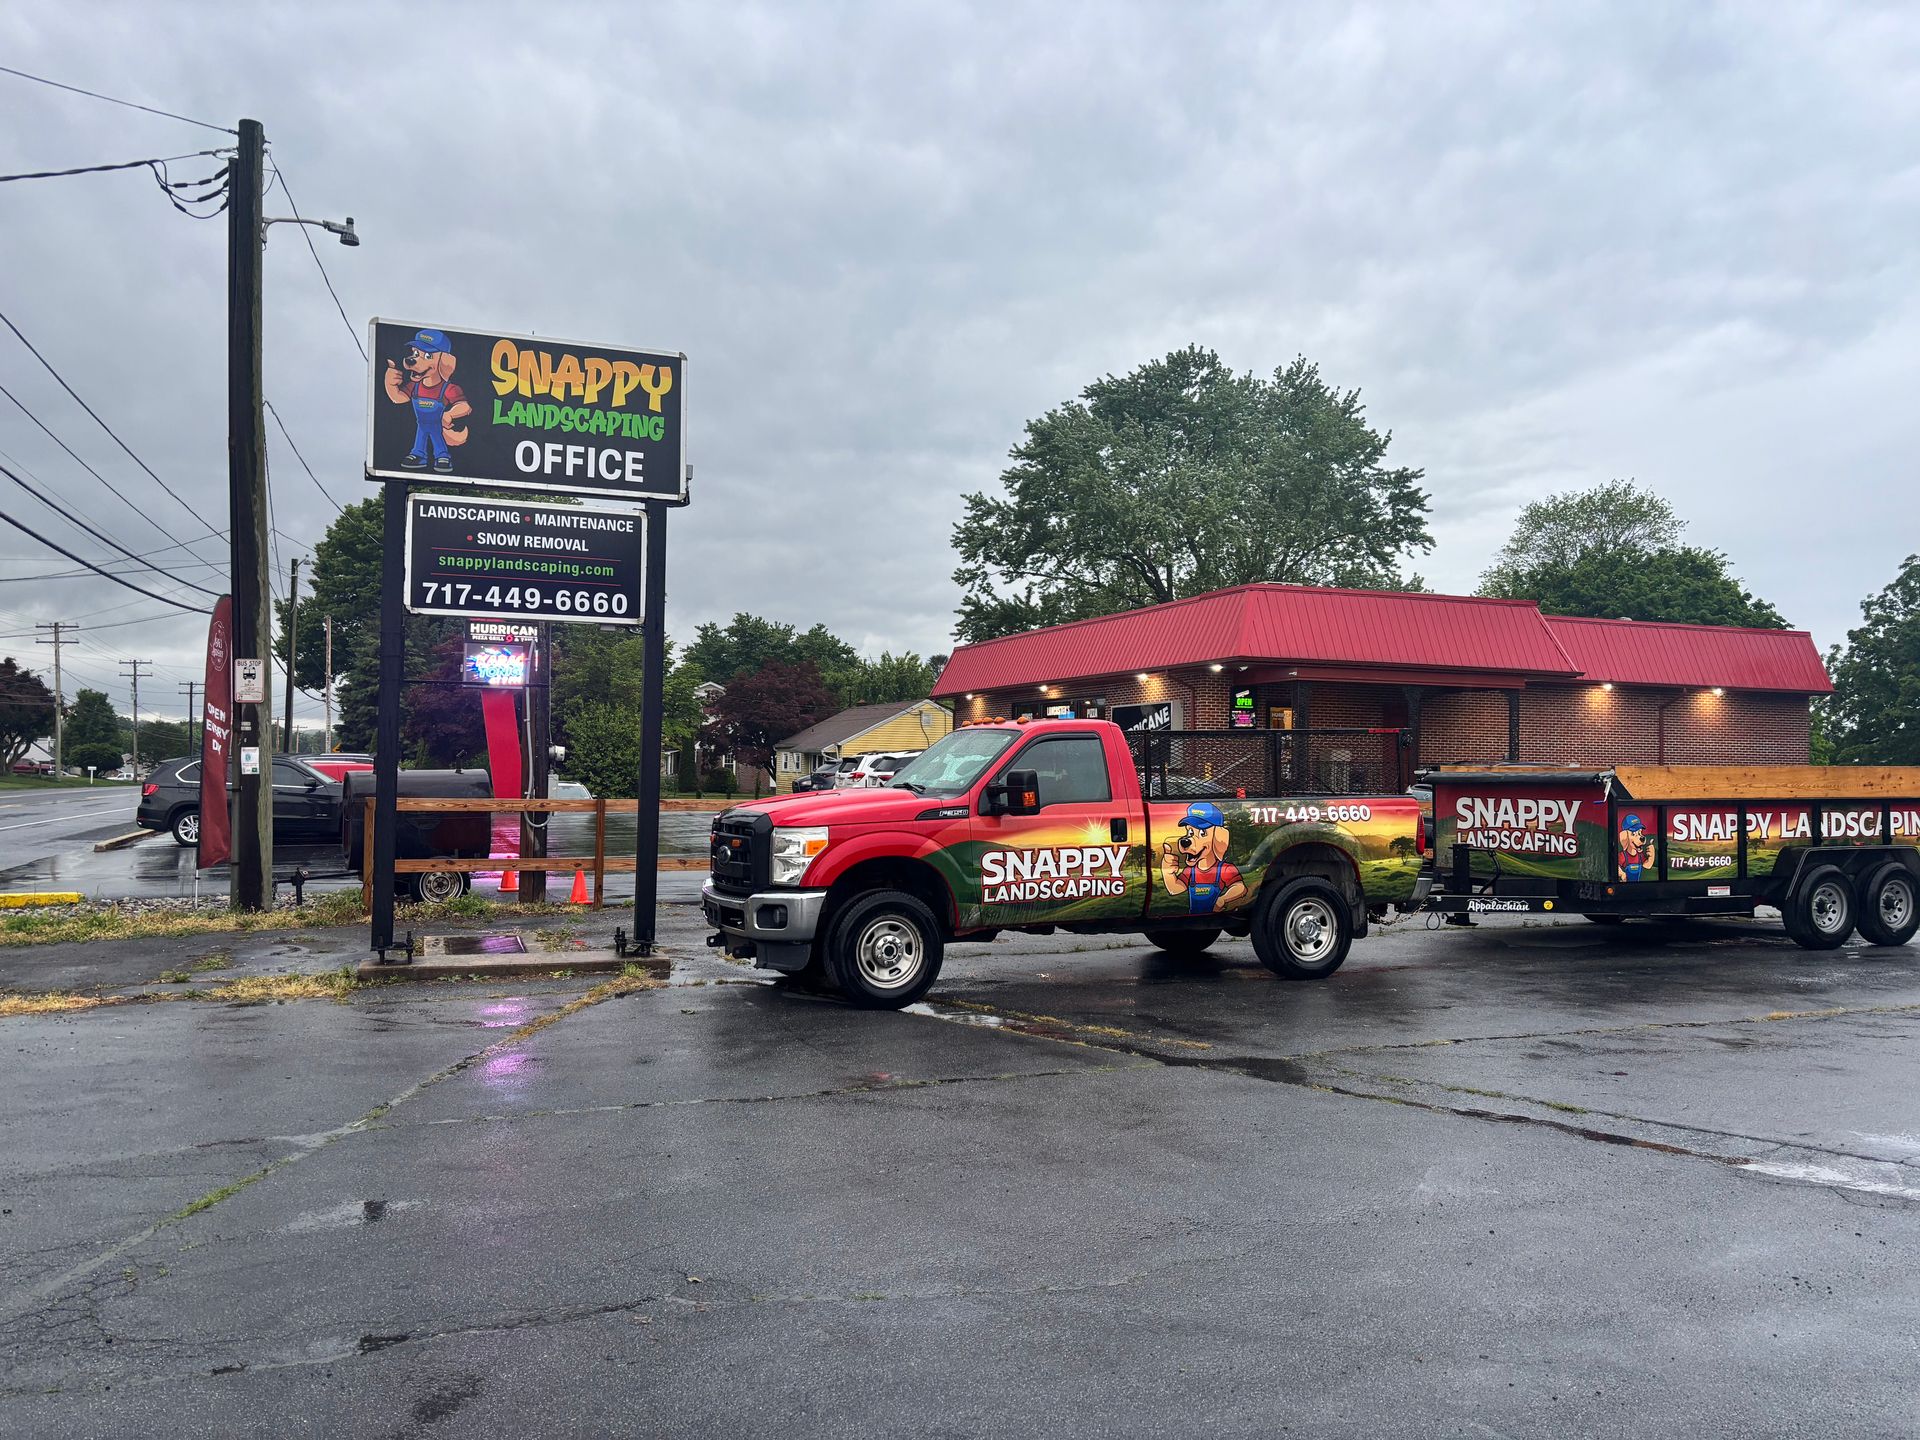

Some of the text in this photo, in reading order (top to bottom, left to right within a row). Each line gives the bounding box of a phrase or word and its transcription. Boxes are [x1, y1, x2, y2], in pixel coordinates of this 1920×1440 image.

[491, 339, 673, 413] SNAPPY
[492, 399, 665, 442] LANDSCAPING
[515, 440, 645, 483] OFFICE
[419, 505, 634, 533] LANDSCAPING MAINTENANCE
[477, 532, 589, 552] SNOW REMOVAL
[438, 555, 614, 577] snappylandscaping.com
[422, 582, 628, 615] 717-449-6660
[470, 623, 538, 636] HURRICAN
[1237, 697, 1252, 706] OPEN
[1250, 805, 1371, 824] 717-449-6660
[1456, 797, 1583, 835] SNAPPY
[1672, 813, 1772, 840] SNAPPY
[1457, 830, 1577, 855] LANDSCAPING
[981, 846, 1130, 886] SNAPPY
[1670, 856, 1732, 868] 717-449-6660
[983, 879, 1125, 903] LANDSCAPING
[1467, 899, 1530, 912] Appalachian
